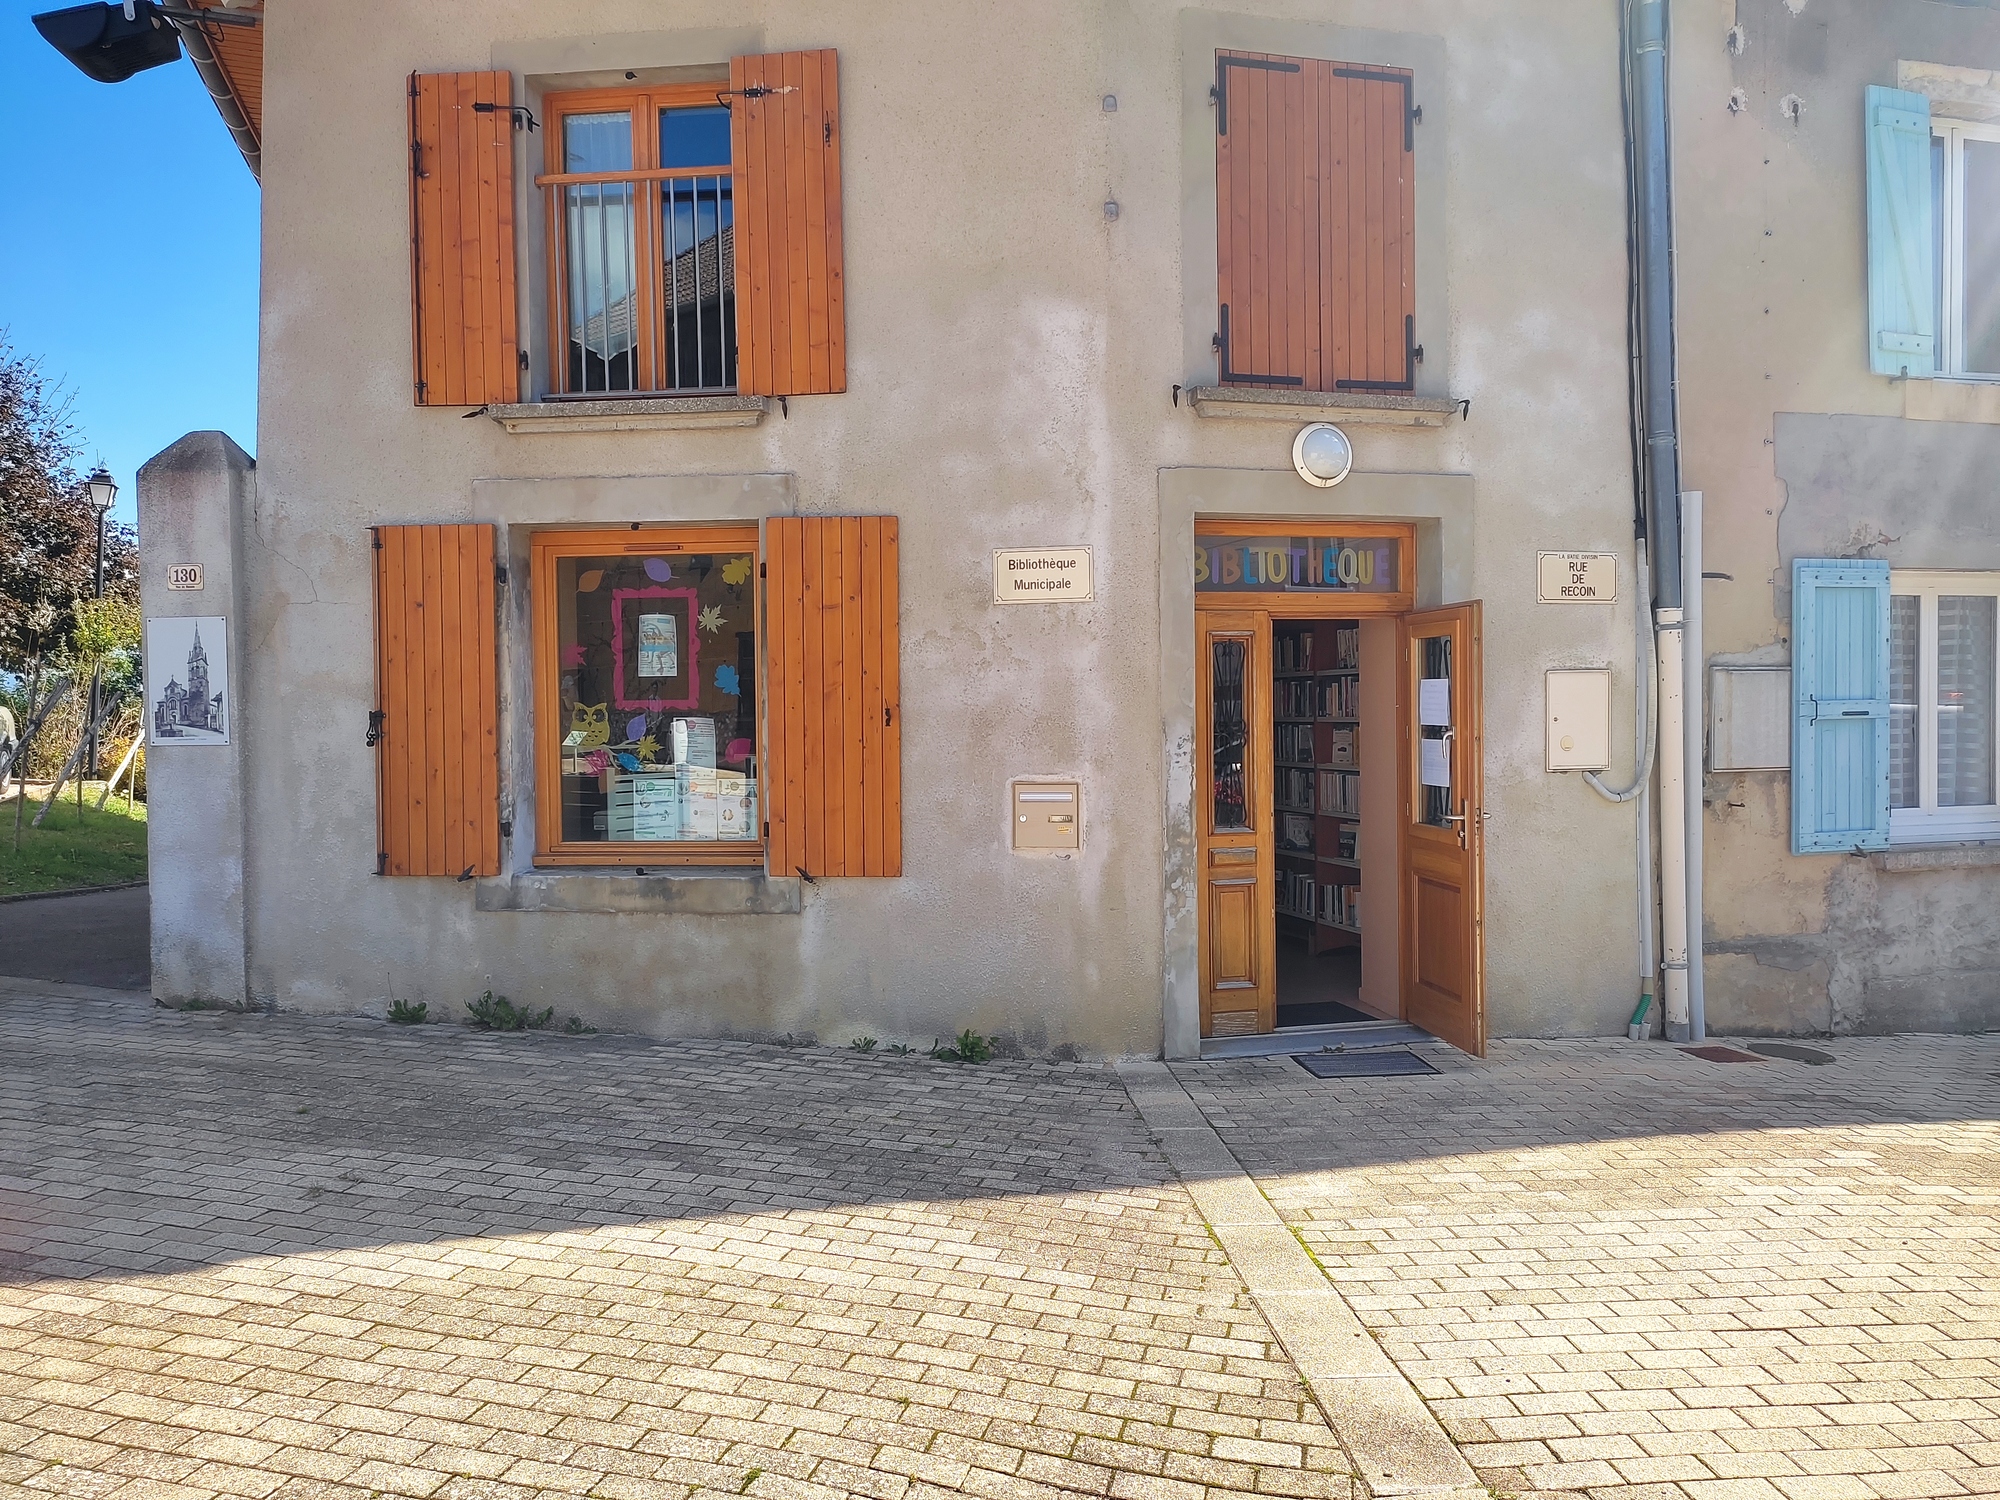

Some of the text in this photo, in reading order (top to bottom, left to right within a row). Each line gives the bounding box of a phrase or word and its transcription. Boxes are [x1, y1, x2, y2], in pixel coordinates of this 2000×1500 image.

[1008, 558, 1077, 571] Bibliothèque
[1195, 545, 1390, 585] BIBLIOTHEQUE
[1569, 561, 1588, 572] RUE
[173, 568, 197, 583] 130
[1571, 573, 1585, 584] DE
[1014, 577, 1072, 591] Municipale
[1561, 586, 1596, 597] RECOIN
